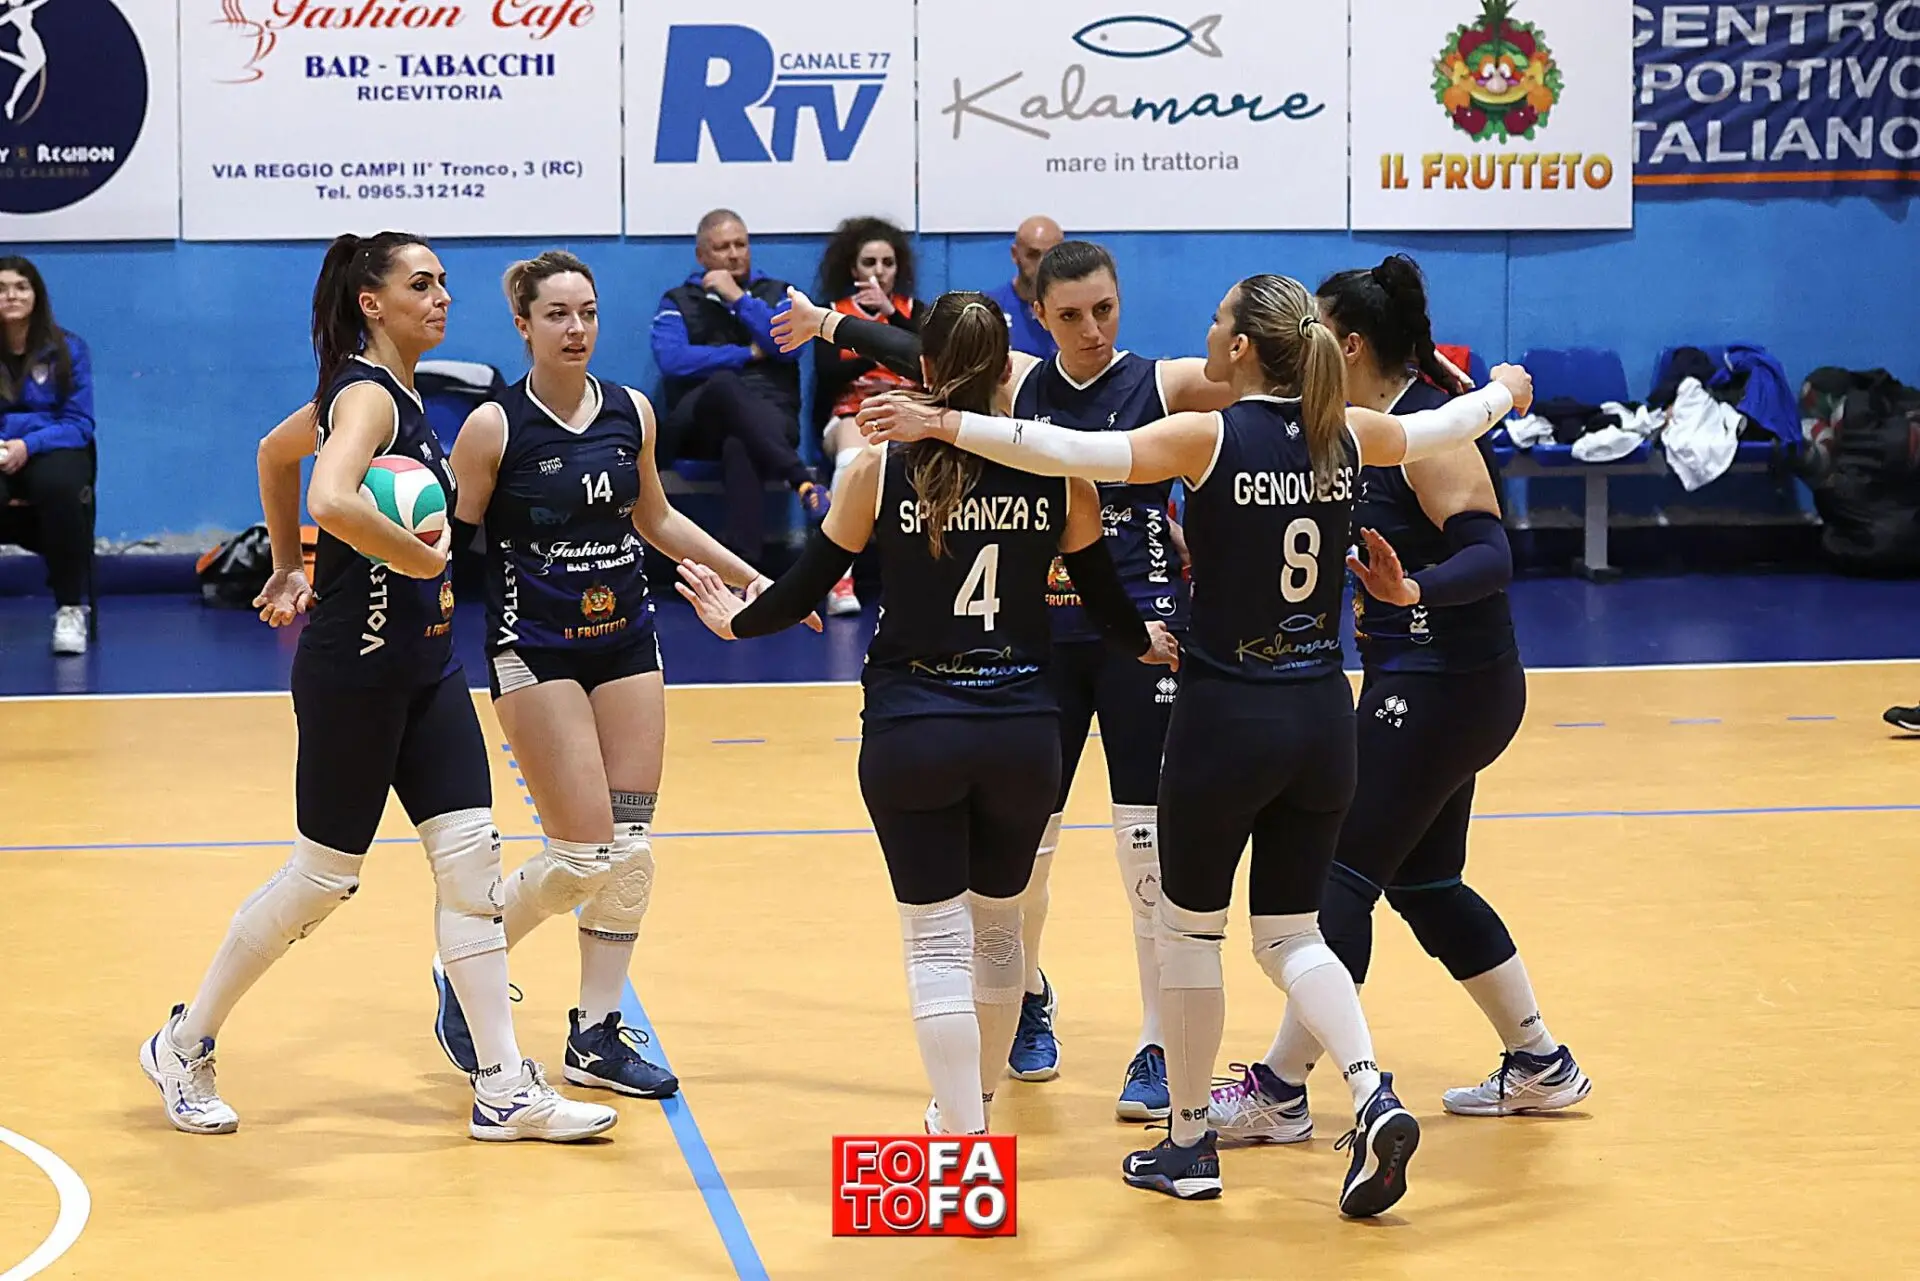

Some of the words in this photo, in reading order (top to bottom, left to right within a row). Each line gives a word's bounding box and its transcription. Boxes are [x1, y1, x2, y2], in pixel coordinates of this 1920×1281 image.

[265, 0, 463, 30] Fashion
[305, 55, 370, 79] BAR
[396, 53, 555, 78] TABACCHI
[780, 53, 861, 70] CANALE
[868, 52, 892, 69] 77
[357, 84, 503, 101] RICEVITORIA
[1633, 56, 1920, 104] PORTIVO
[941, 63, 1325, 140] Kalamare
[212, 163, 248, 179] VIA
[254, 163, 334, 178] REGGIO
[341, 162, 406, 177] CAMPI
[440, 161, 518, 178] Tronco,
[523, 161, 535, 176] 3
[541, 160, 584, 177] (RC)
[1046, 157, 1107, 173] mare
[1114, 153, 1135, 172] in
[1142, 151, 1240, 171] trattoria
[1380, 152, 1409, 190] IL
[1421, 152, 1614, 190] FRUTTETO
[316, 185, 352, 199] Tel.
[358, 183, 486, 199] 0965.312142
[581, 471, 613, 505] 14
[899, 496, 1029, 534] SPRANZA
[1034, 497, 1050, 532] S.
[547, 541, 617, 558] Fashion
[1280, 517, 1321, 603] 8
[953, 543, 1000, 632] 4
[577, 617, 627, 639] FRUTTETO
